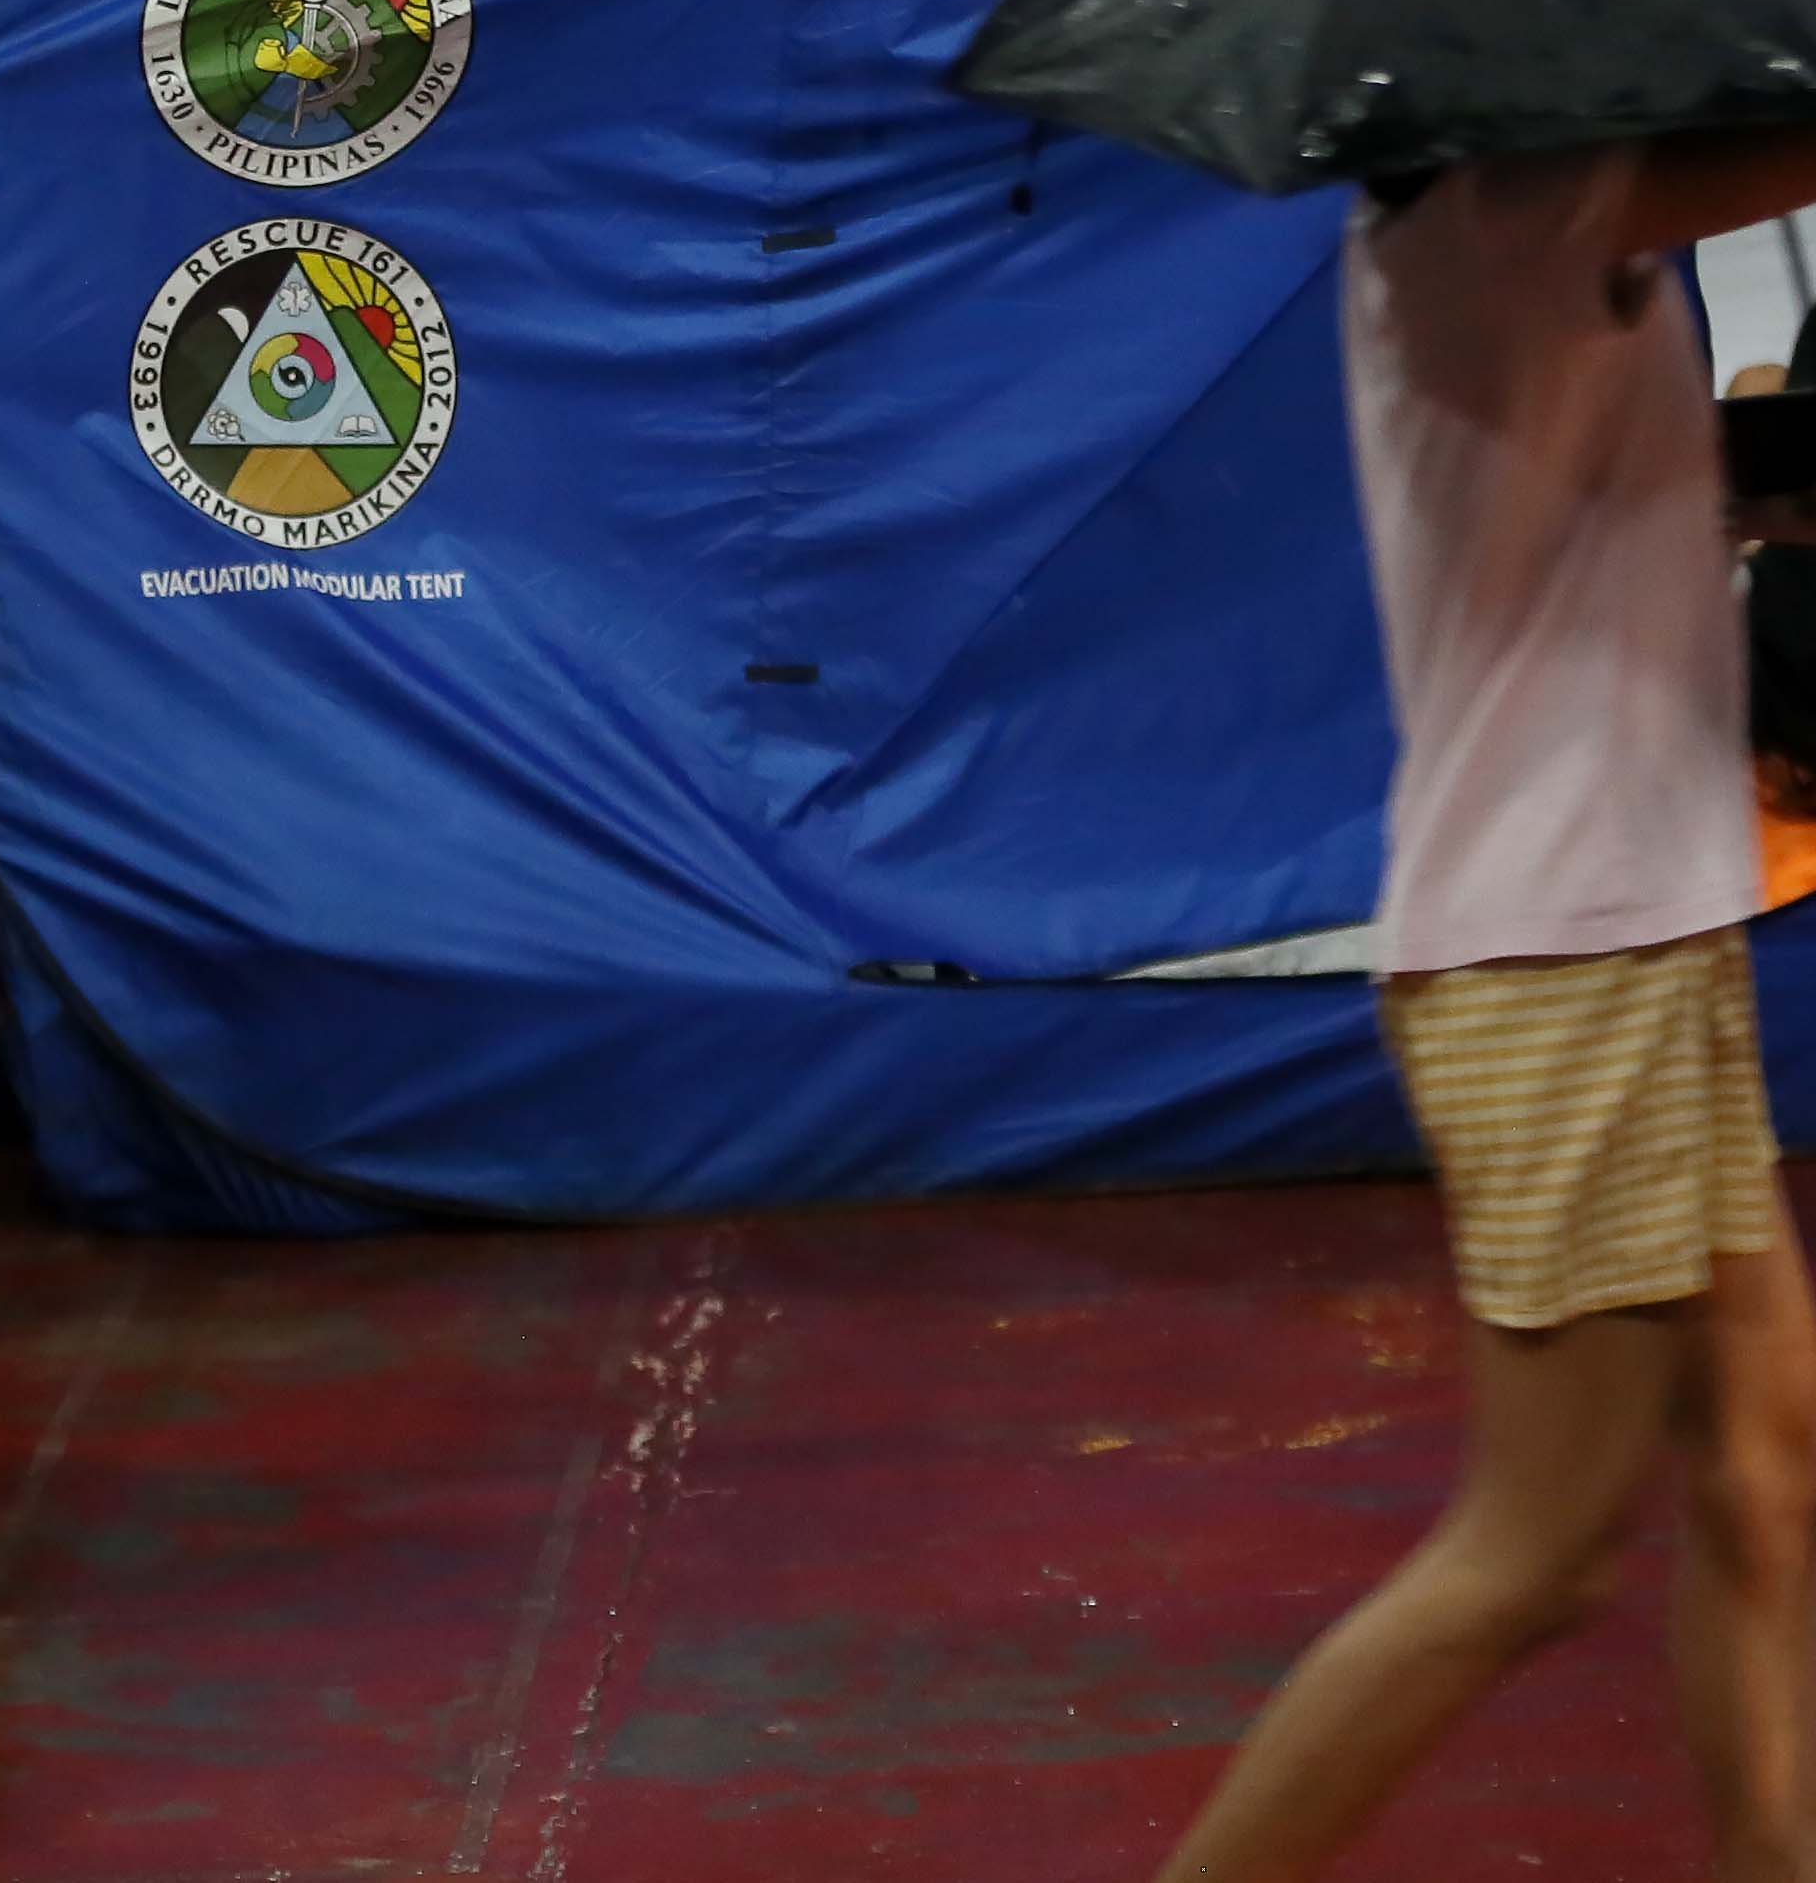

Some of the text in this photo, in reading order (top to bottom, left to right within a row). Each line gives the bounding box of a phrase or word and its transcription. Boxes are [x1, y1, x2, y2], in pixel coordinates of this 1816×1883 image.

[150, 51, 456, 179] 1630 PILIPINAS 1996
[184, 220, 410, 286] RESCUE 161
[133, 320, 169, 410] 1993
[422, 320, 453, 410] 2012
[150, 440, 441, 547] DRRMO MARIKINA
[140, 563, 466, 602] EVACUATION MODULAR TENT
